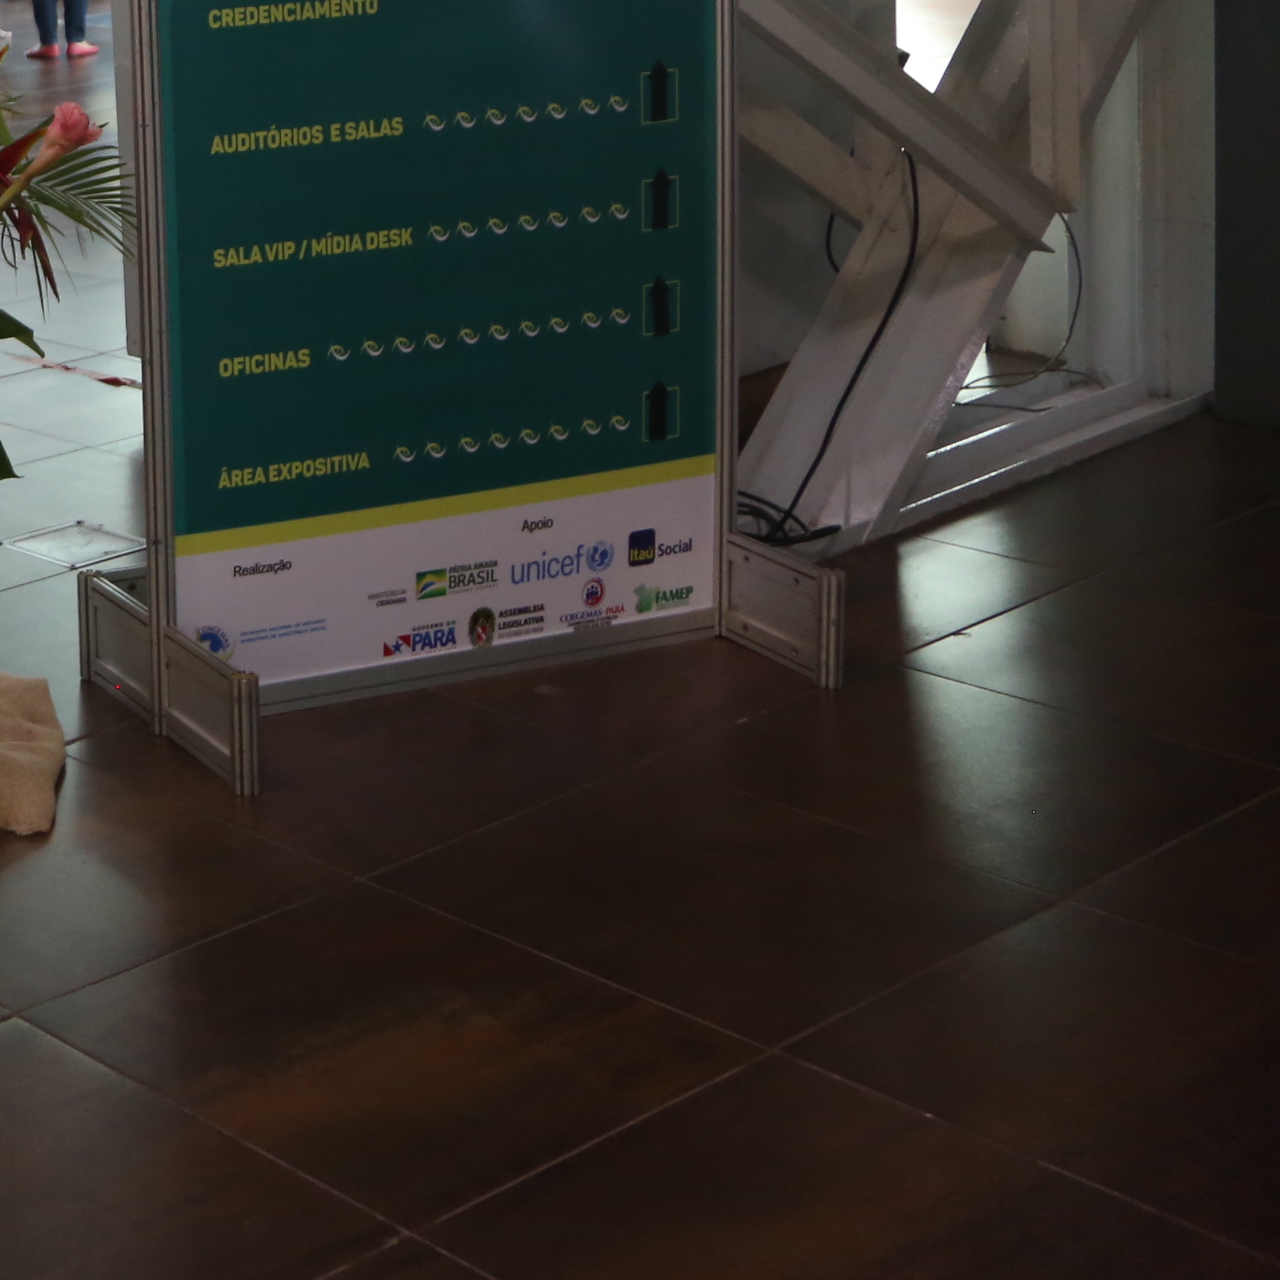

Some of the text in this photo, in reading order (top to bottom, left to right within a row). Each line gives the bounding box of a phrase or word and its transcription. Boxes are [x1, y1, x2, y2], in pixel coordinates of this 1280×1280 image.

[211, 117, 404, 154] AUDITÓRIOS E SALAS
[213, 245, 263, 268] SALA
[264, 241, 296, 263] VIP
[311, 231, 364, 258] MÍDIA
[367, 227, 414, 252] DESK
[218, 348, 311, 378] OFICINAS
[218, 452, 370, 489] ÁREA EXPOSITIVA
[521, 516, 554, 534] Apoio
[657, 538, 692, 557] Social
[233, 559, 292, 578] Realização
[510, 544, 585, 585] unicef
[448, 569, 498, 590] BRASIL
[655, 585, 694, 604] FAMEP
[498, 603, 545, 618] ASSEMBLEIA
